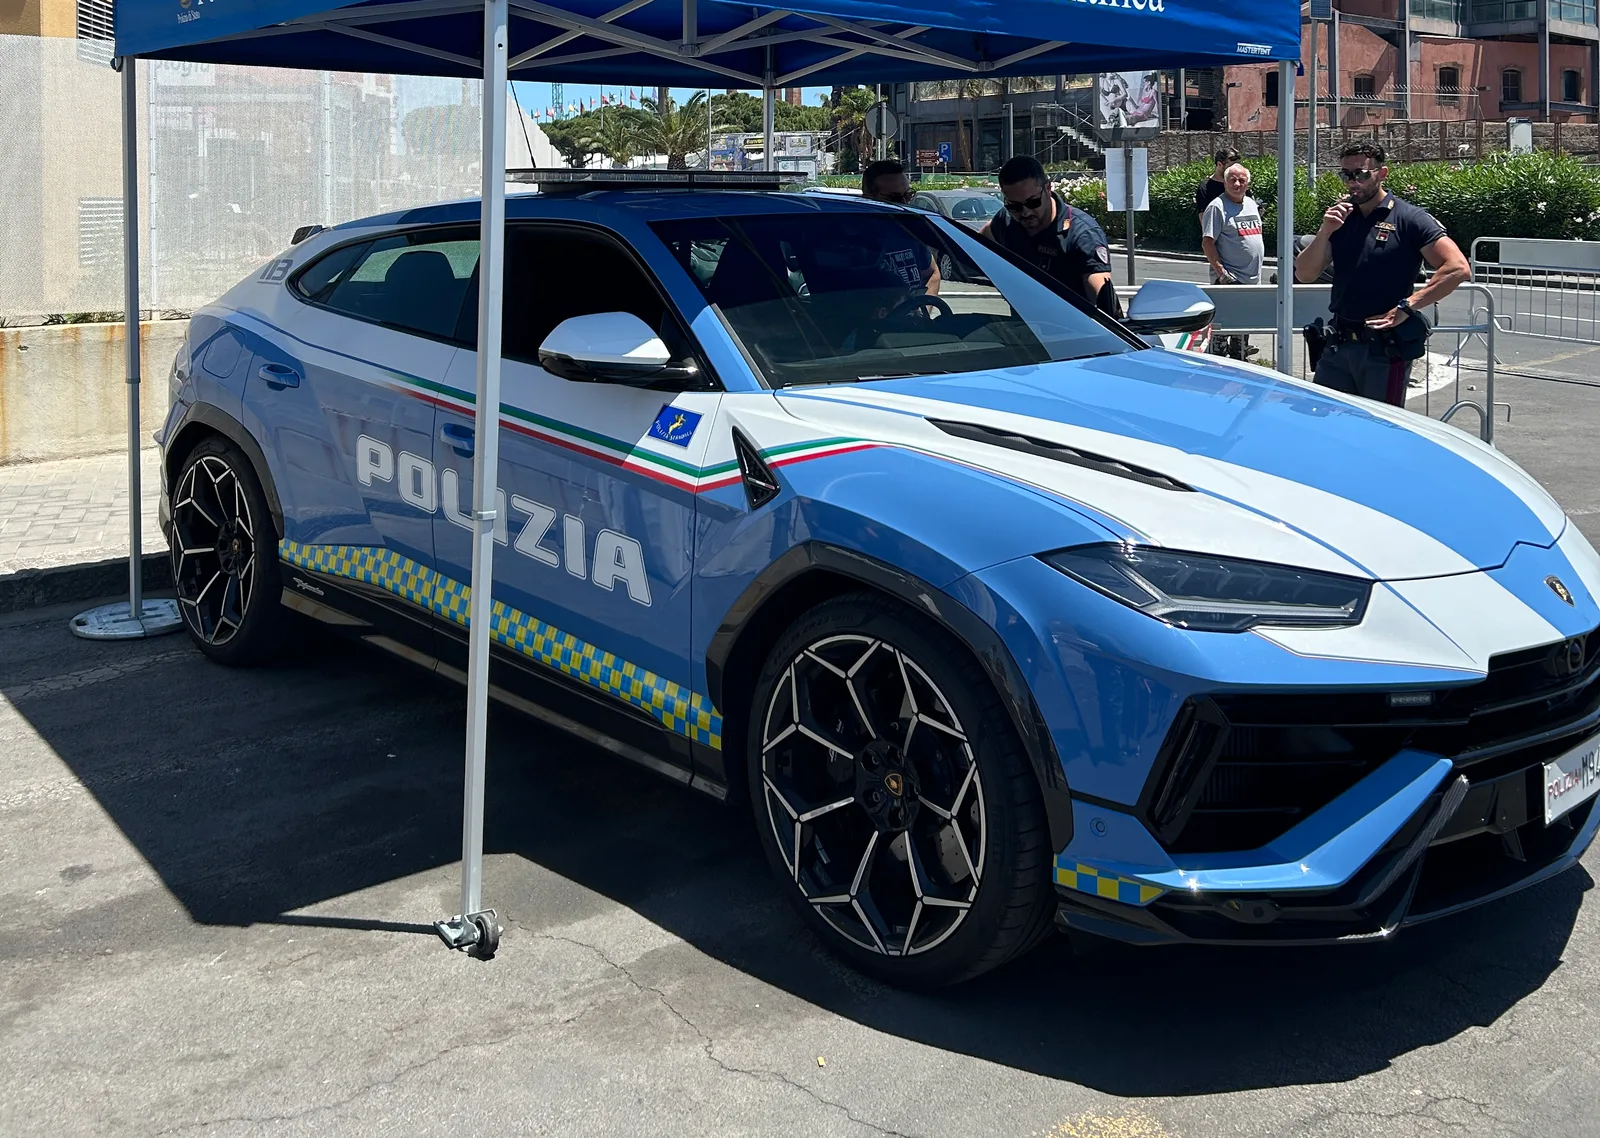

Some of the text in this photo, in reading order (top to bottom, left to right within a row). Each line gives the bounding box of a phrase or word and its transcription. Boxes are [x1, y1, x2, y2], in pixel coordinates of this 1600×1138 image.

[1236, 45, 1271, 56] MASTERTENT
[941, 144, 949, 153] P
[356, 433, 652, 607] POLIZIA
